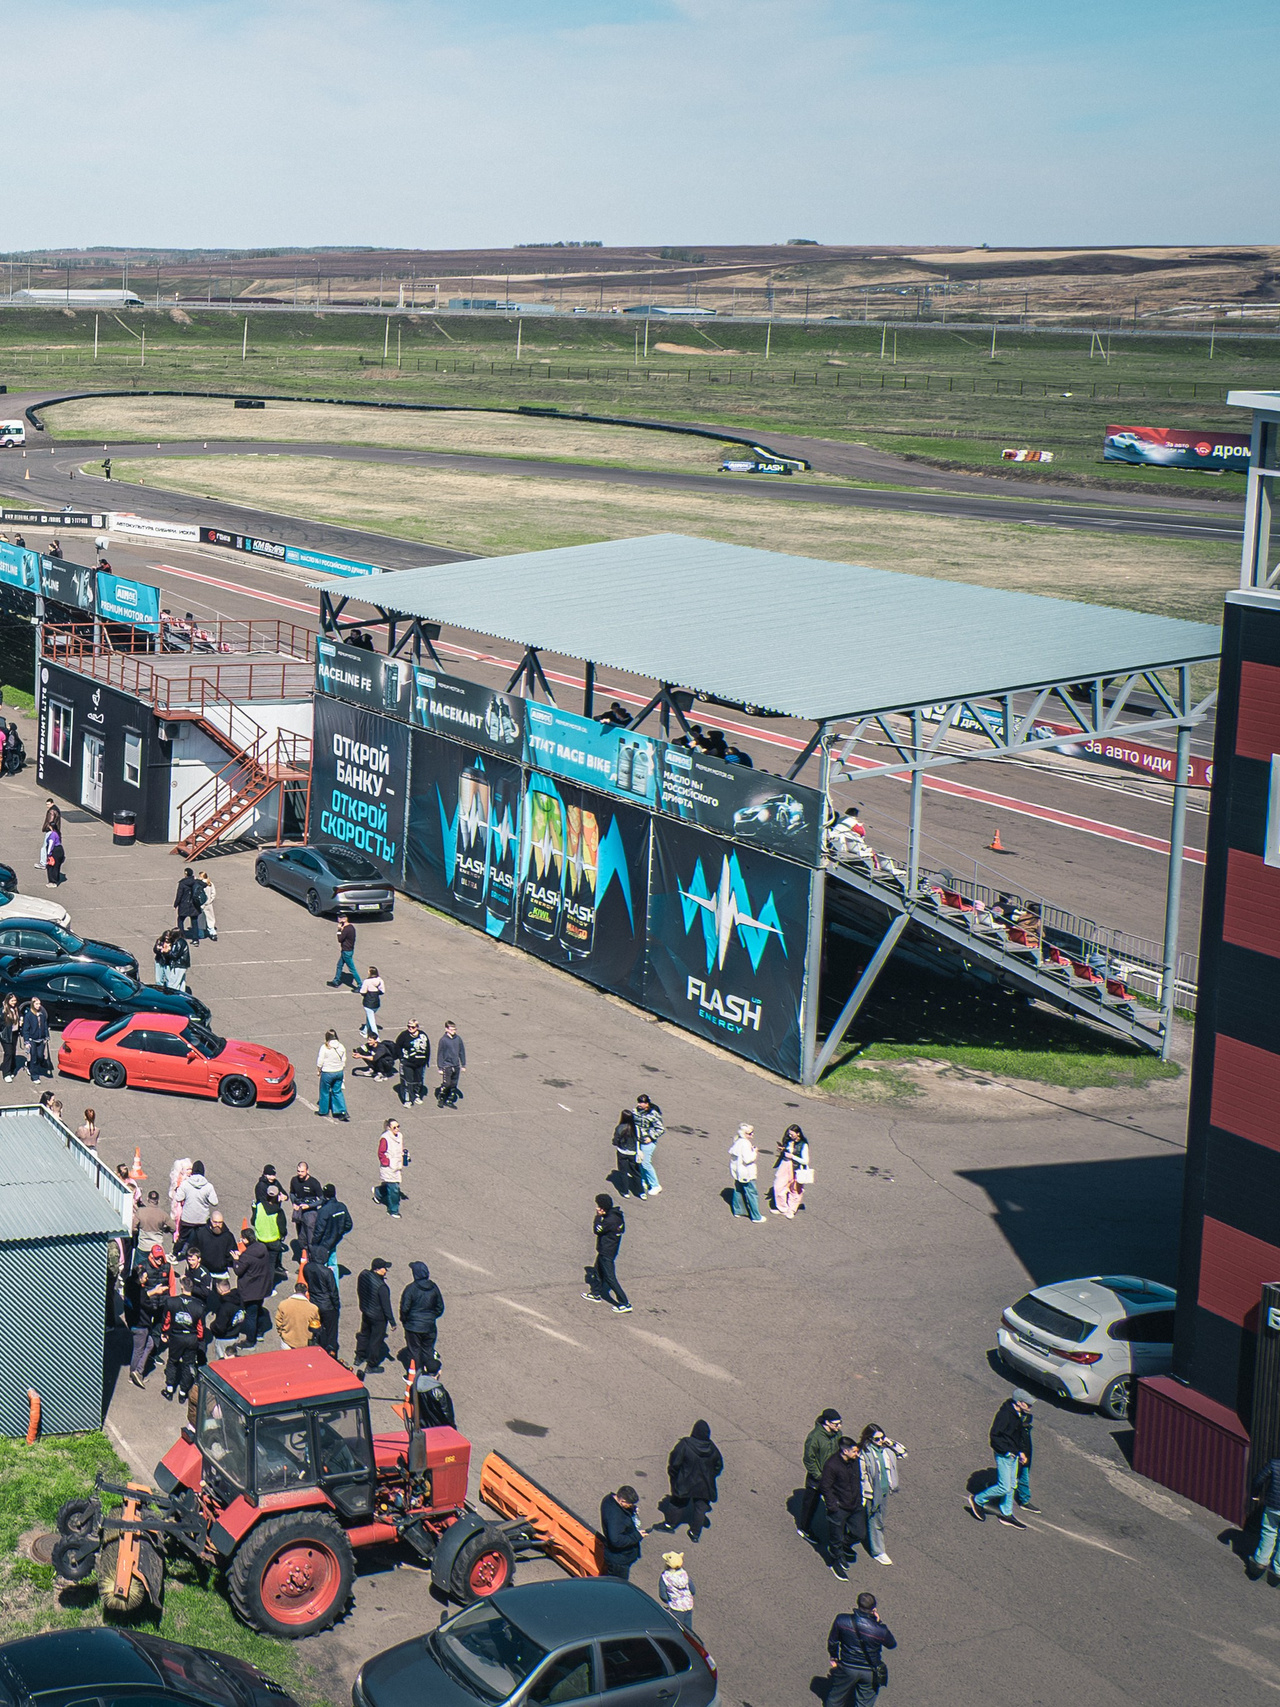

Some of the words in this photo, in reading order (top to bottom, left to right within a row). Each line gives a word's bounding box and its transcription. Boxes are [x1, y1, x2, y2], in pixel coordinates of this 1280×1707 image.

[758, 463, 784, 471] FLASH
[101, 601, 123, 615] PREMIUM
[123, 608, 143, 622] MOTOR
[318, 663, 360, 689] RACELINE
[361, 676, 372, 692] FE
[416, 696, 428, 711] 2T
[429, 701, 484, 729] RACEKART
[333, 733, 390, 775] ОТКРОЙ
[528, 734, 556, 755] 2T/4T
[556, 743, 585, 765] RACE
[586, 753, 612, 774] BIKE
[1084, 739, 1102, 755] За
[1105, 745, 1139, 765] авто
[1142, 755, 1172, 773] иди
[336, 759, 383, 797] БАНКУ
[663, 770, 690, 787] МАСЛО
[692, 778, 703, 791] №1
[662, 782, 719, 807] РОССИЙСКОГО
[662, 791, 694, 810] ДРИФТА
[331, 789, 388, 833] ОТКРОЙ
[320, 810, 396, 864] СКОРОСТЬ!
[455, 853, 485, 875] FLASH
[489, 865, 514, 888] FLASH
[525, 882, 560, 907] FLASH
[530, 897, 554, 910] ENERGY
[563, 898, 595, 923] FLASH
[687, 975, 762, 1031] FLASH
[698, 1008, 743, 1034] ENERGY
